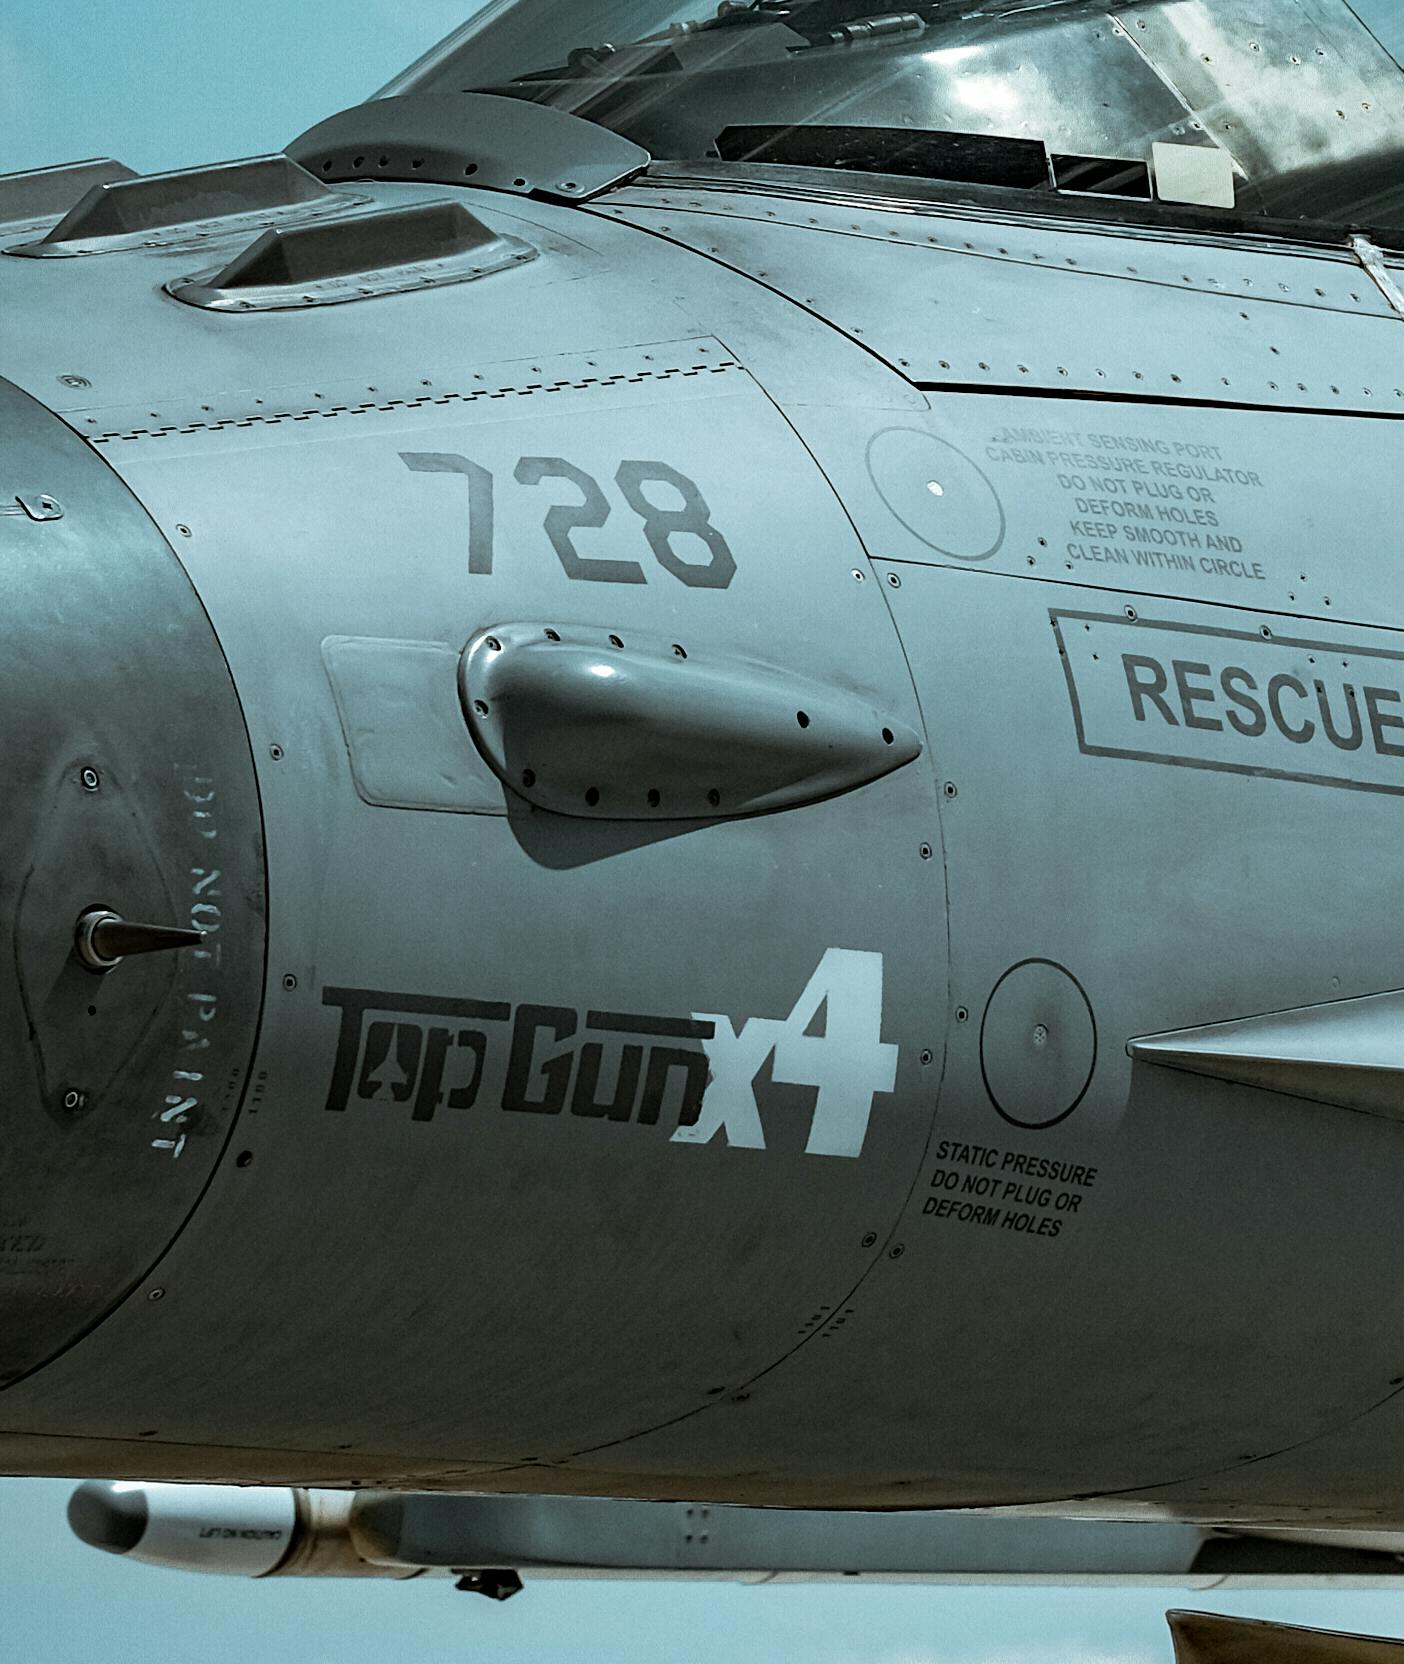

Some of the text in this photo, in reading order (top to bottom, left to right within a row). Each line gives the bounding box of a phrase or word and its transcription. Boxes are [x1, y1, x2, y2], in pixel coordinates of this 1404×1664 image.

[985, 446, 1265, 488] CABIN PRESSURE REGULATOR
[1087, 433, 1170, 456] SENSING
[1174, 441, 1223, 462] PORT
[1057, 473, 1217, 505] DO NOT PLUG OR
[398, 452, 737, 589] 728
[1074, 497, 1219, 528] DEFORM HOLES
[1069, 520, 1243, 554] KEEP SMOOTH AND
[1066, 542, 1267, 581] CLEAN WITHIN CIRCLE
[150, 992, 218, 1160] PAINT
[935, 1140, 1099, 1188] STATIC PRESSURE
[930, 1168, 1084, 1214] DO NOT PLUG OR
[921, 1196, 1064, 1238] DEFORM HOLES
